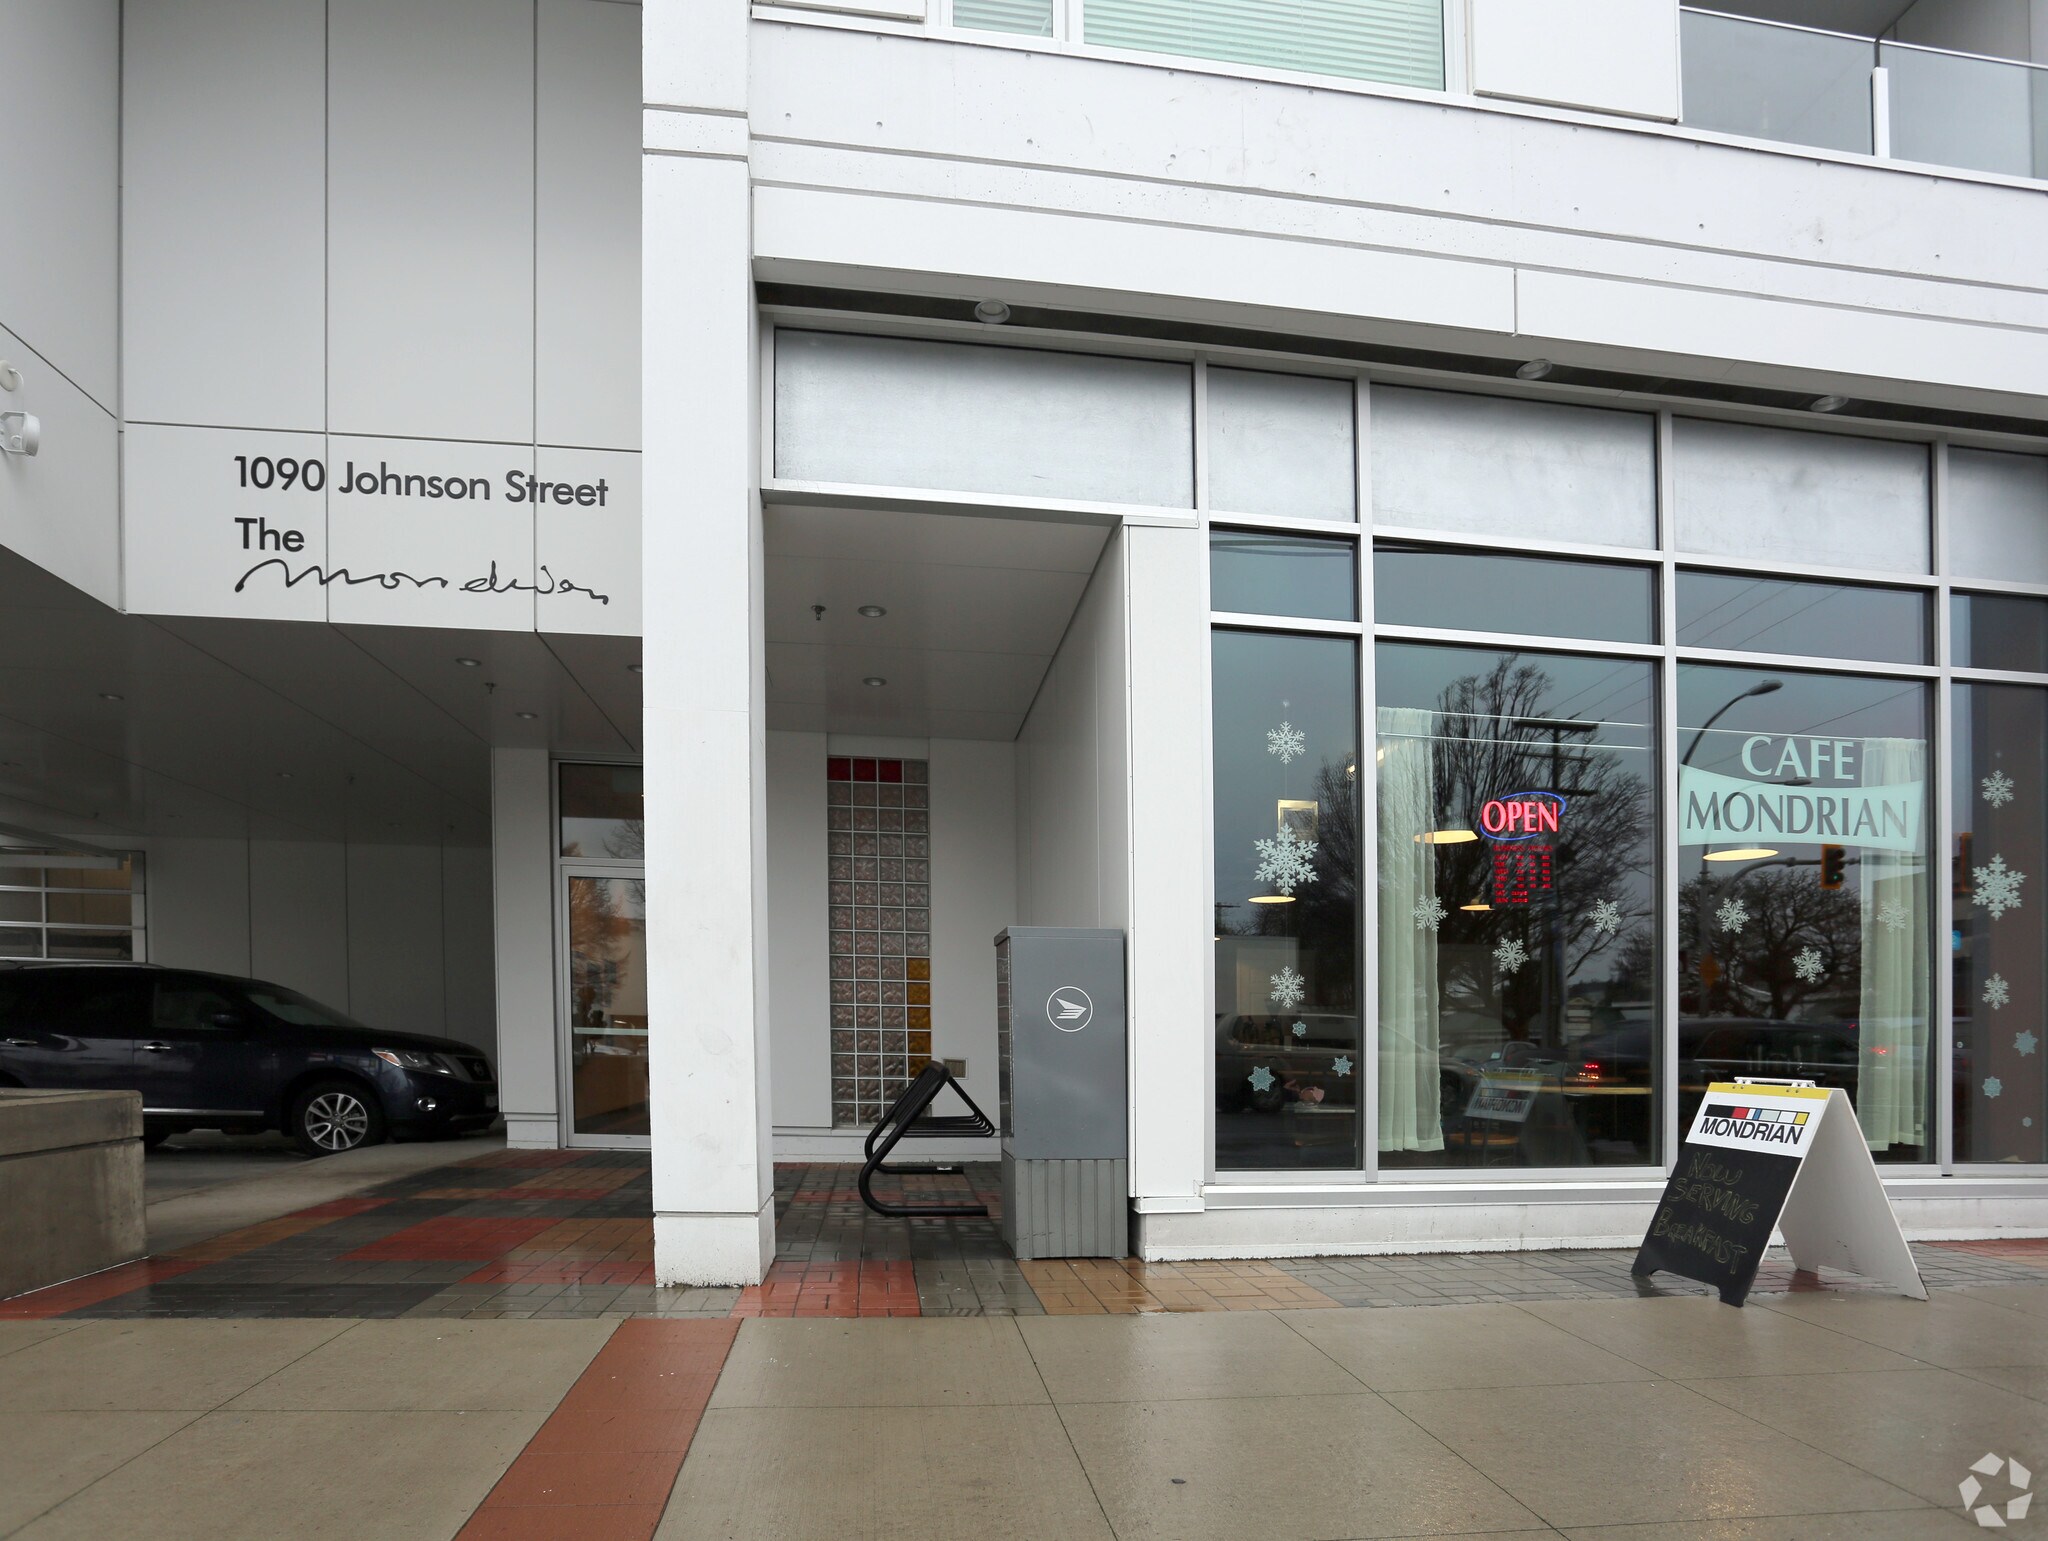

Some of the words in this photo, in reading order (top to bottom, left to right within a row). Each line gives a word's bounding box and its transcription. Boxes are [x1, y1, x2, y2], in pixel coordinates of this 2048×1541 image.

[234, 456, 326, 491] 1090
[338, 461, 491, 500] Johnson
[505, 470, 609, 506] Street
[234, 517, 305, 552] The
[1741, 735, 1855, 780] CAFE
[1481, 800, 1559, 832] OPEN
[1686, 790, 1907, 838] MONDRIAN
[1699, 1117, 1804, 1145] MONDRIAN
[1667, 1177, 1760, 1224] SERVING
[1653, 1206, 1748, 1275] BREAKFAST
